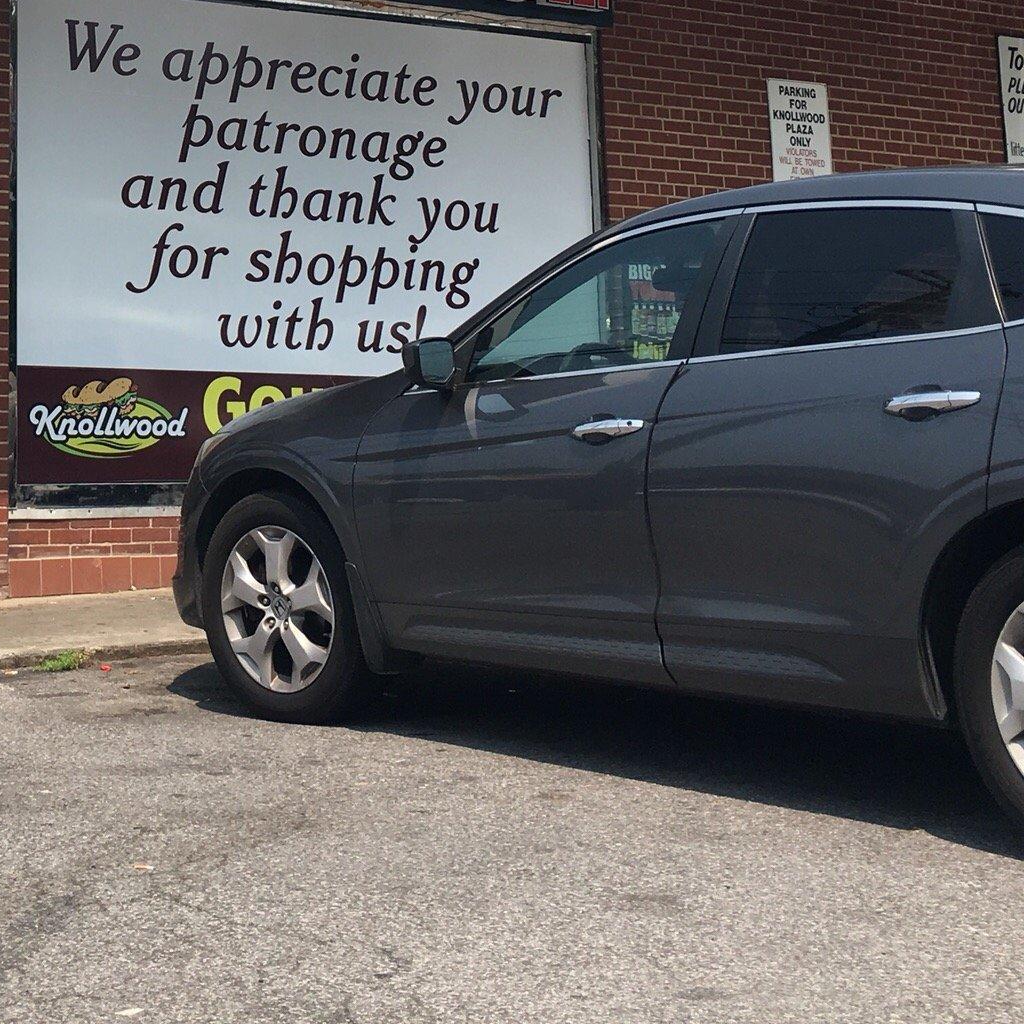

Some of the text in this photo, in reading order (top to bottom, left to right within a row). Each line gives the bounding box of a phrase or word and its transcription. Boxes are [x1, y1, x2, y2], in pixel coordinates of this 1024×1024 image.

[64, 19, 562, 125] We appreciate your
[778, 85, 816, 98] PARKING
[789, 99, 807, 110] FOR
[772, 110, 825, 124] KNOLLWOOD
[786, 123, 814, 135] PLAZA
[178, 103, 448, 180] patronage
[789, 136, 811, 147] ONLY
[785, 148, 817, 157] VIOLATORS
[779, 156, 825, 167] WILL BE TOWED
[121, 162, 500, 244] and thank you
[126, 223, 480, 309] for shopping
[219, 297, 427, 353] with us!
[29, 403, 187, 440] Knollwood
